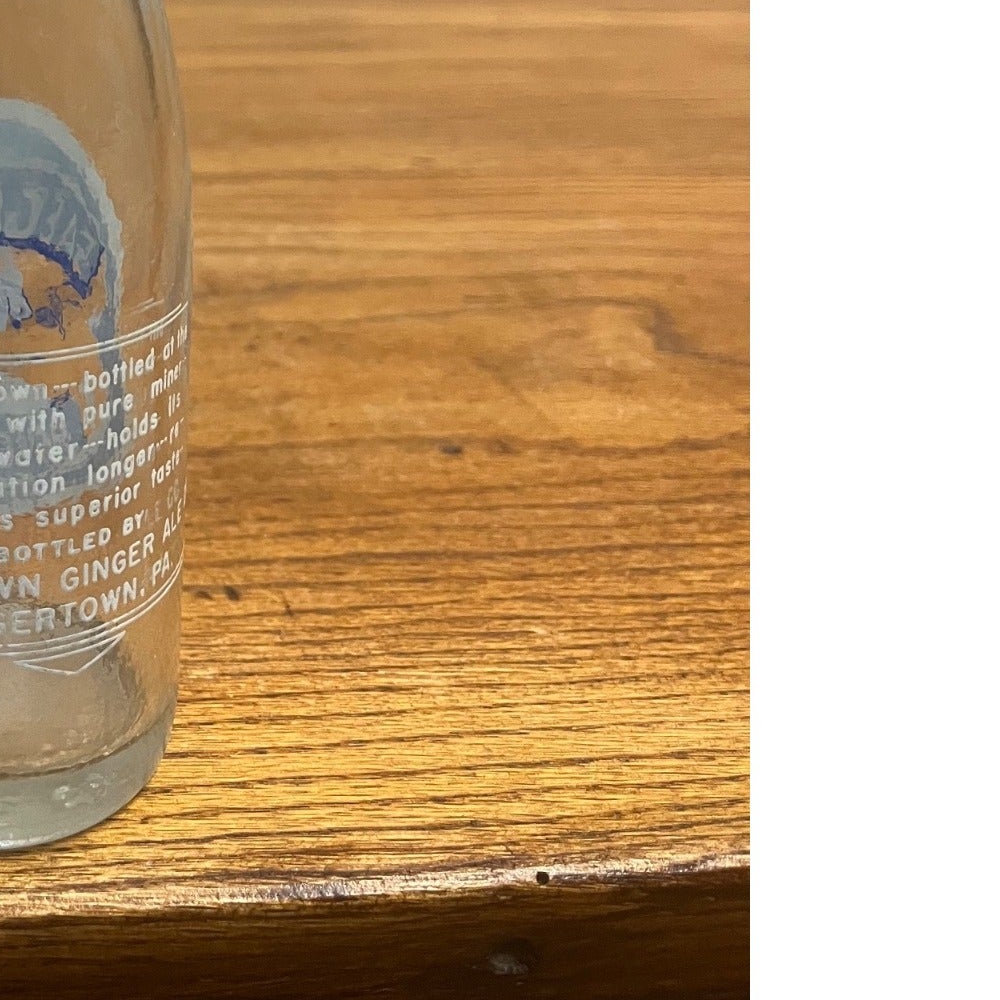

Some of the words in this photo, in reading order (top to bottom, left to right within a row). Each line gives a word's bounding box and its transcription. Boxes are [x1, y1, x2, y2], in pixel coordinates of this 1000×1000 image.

[163, 335, 175, 361] at
[83, 393, 134, 431] pure
[35, 482, 141, 529] superior
[122, 508, 145, 537] BY
[60, 532, 155, 592] GINGER
[162, 498, 183, 544] ALE
